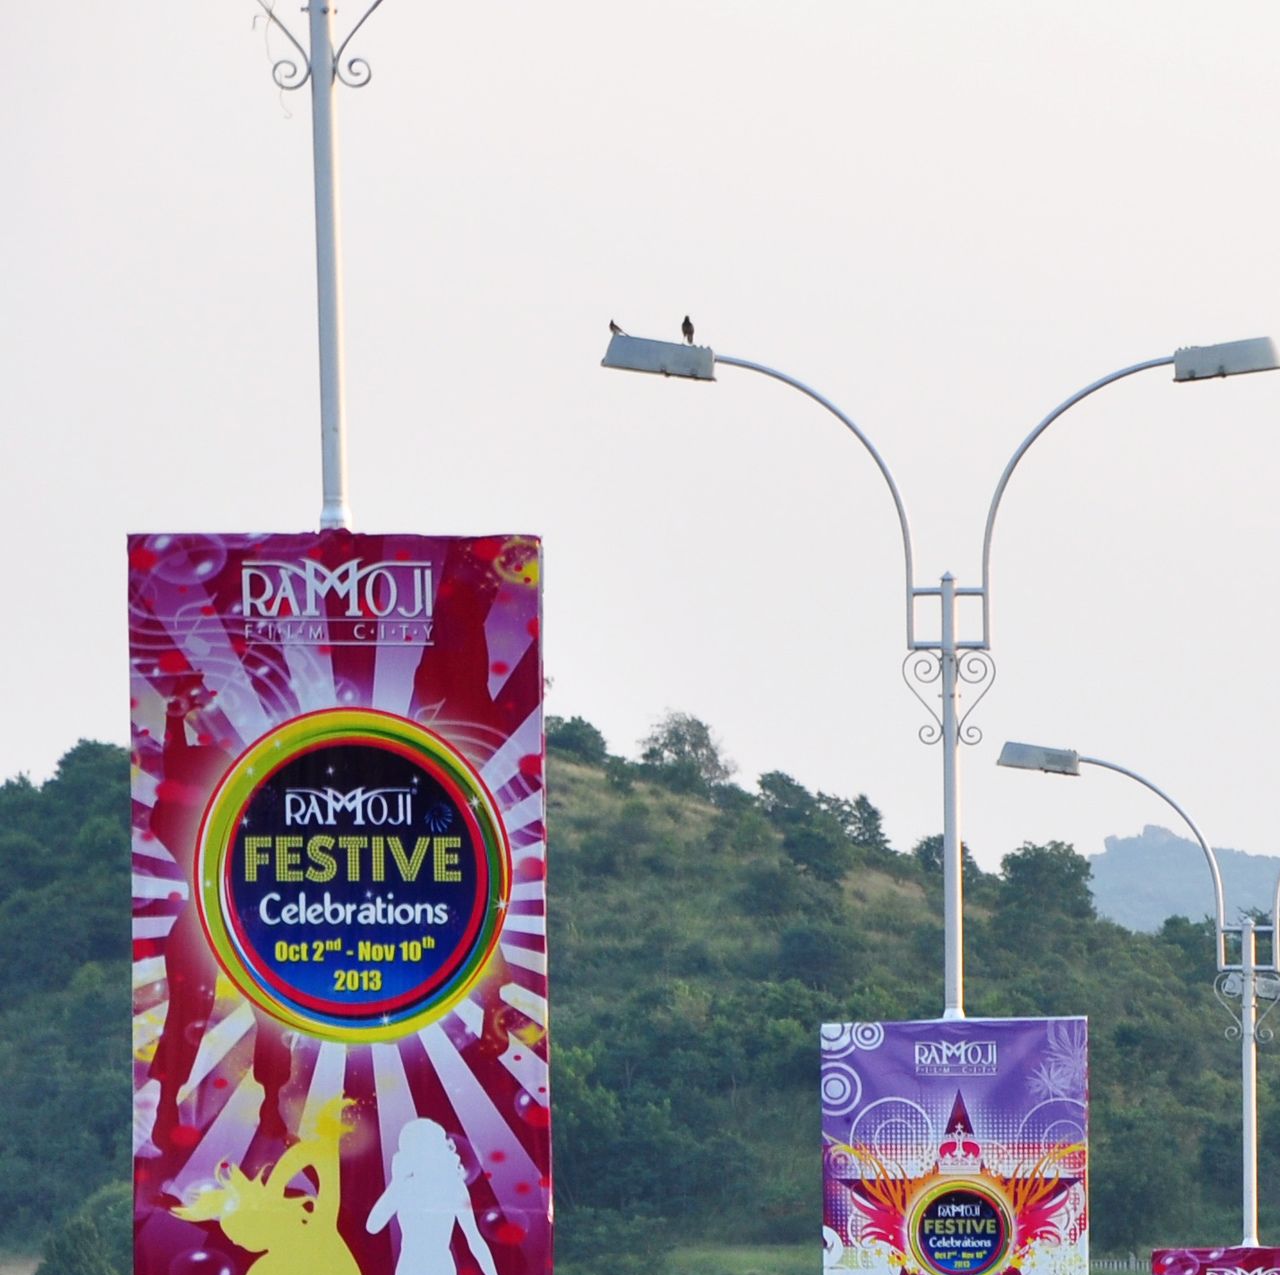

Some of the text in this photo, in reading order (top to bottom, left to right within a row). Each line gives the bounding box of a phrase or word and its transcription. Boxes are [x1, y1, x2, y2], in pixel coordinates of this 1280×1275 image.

[241, 558, 433, 617] RAMOJI
[285, 787, 412, 826] RAMOJI
[244, 835, 462, 883] FESTIVE
[258, 891, 449, 925] Celebrations
[274, 940, 308, 962] Oct
[312, 938, 342, 962] 2nd
[357, 941, 396, 962] Nov
[399, 936, 435, 962] 10th
[333, 969, 383, 991] 2013
[914, 1039, 997, 1065] RAMOJI
[938, 1204, 980, 1217] RAMOJI
[924, 1219, 997, 1234] FESTIVE
[928, 1236, 992, 1248] Celebrations
